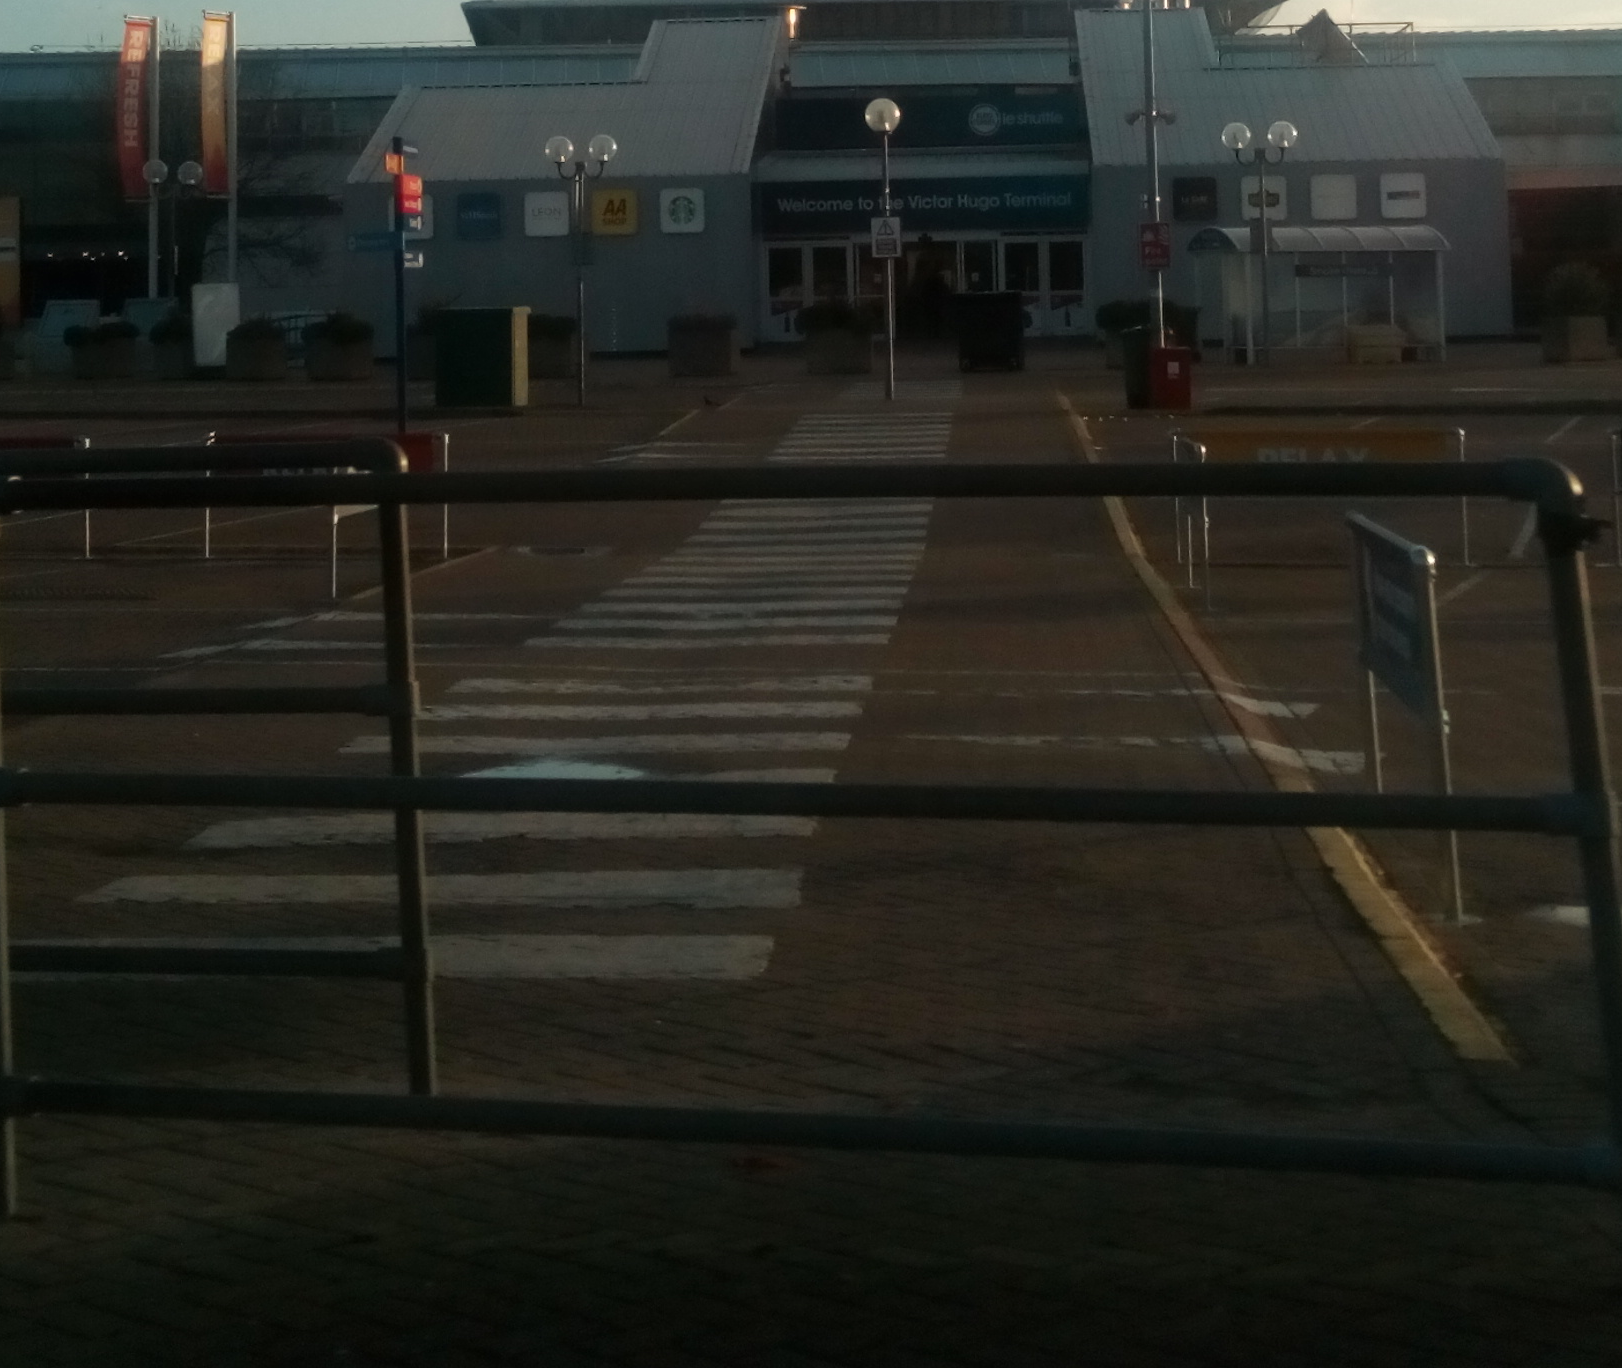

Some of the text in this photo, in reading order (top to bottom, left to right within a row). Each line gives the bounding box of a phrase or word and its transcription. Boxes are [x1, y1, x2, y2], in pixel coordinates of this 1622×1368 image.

[123, 30, 144, 148] REFRESH
[1002, 112, 1016, 125] le
[1017, 111, 1064, 125] shuttle
[603, 198, 627, 216] AA
[777, 197, 854, 212] Welcome
[858, 196, 874, 211] to
[907, 194, 954, 209] Victor
[957, 193, 1000, 212] Hugo
[1003, 191, 1072, 207] Terminal
[602, 217, 627, 226] SHOP
